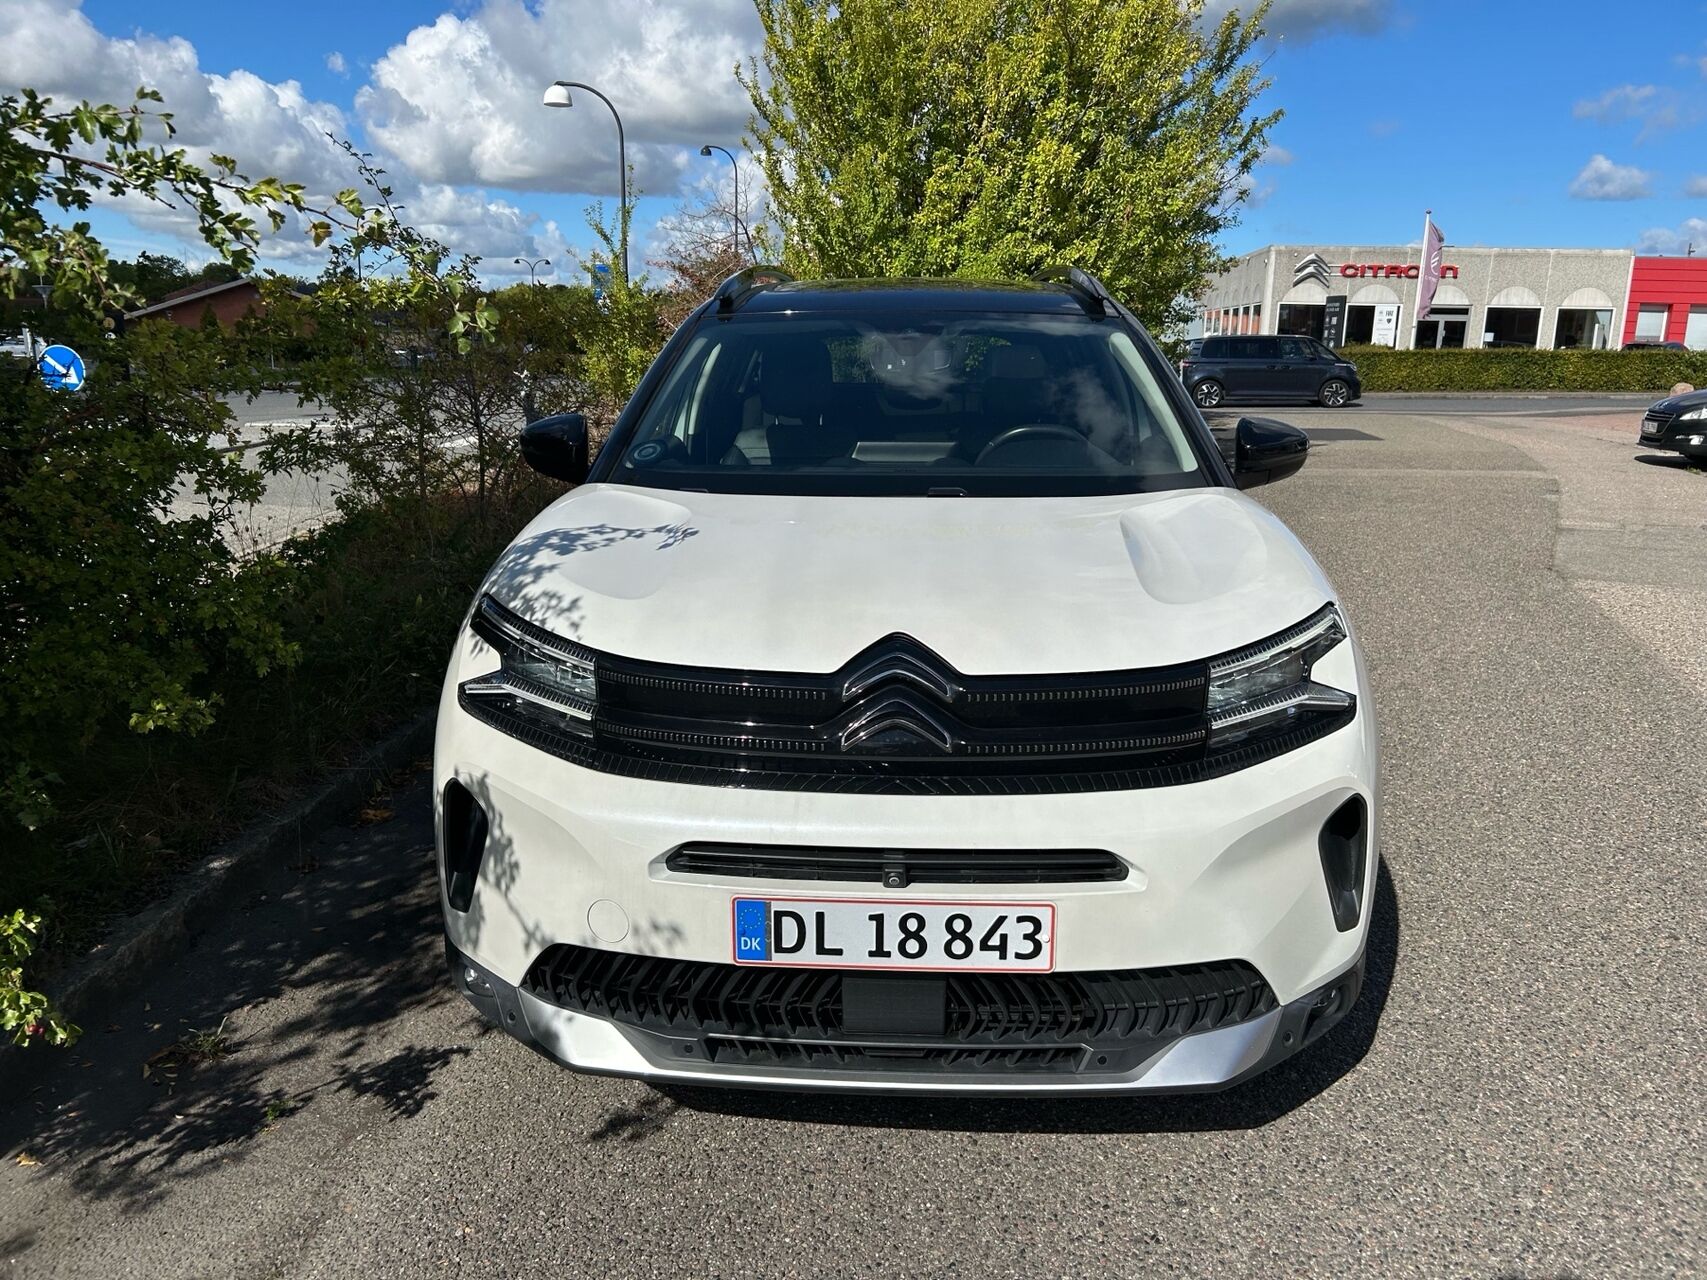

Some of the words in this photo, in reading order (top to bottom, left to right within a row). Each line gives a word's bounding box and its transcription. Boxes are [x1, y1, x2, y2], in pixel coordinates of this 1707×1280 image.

[1340, 264, 1459, 279] CITRON
[773, 909, 844, 956] DL
[867, 912, 928, 959] 18
[943, 913, 1043, 960] 843
[740, 936, 762, 951] DK
